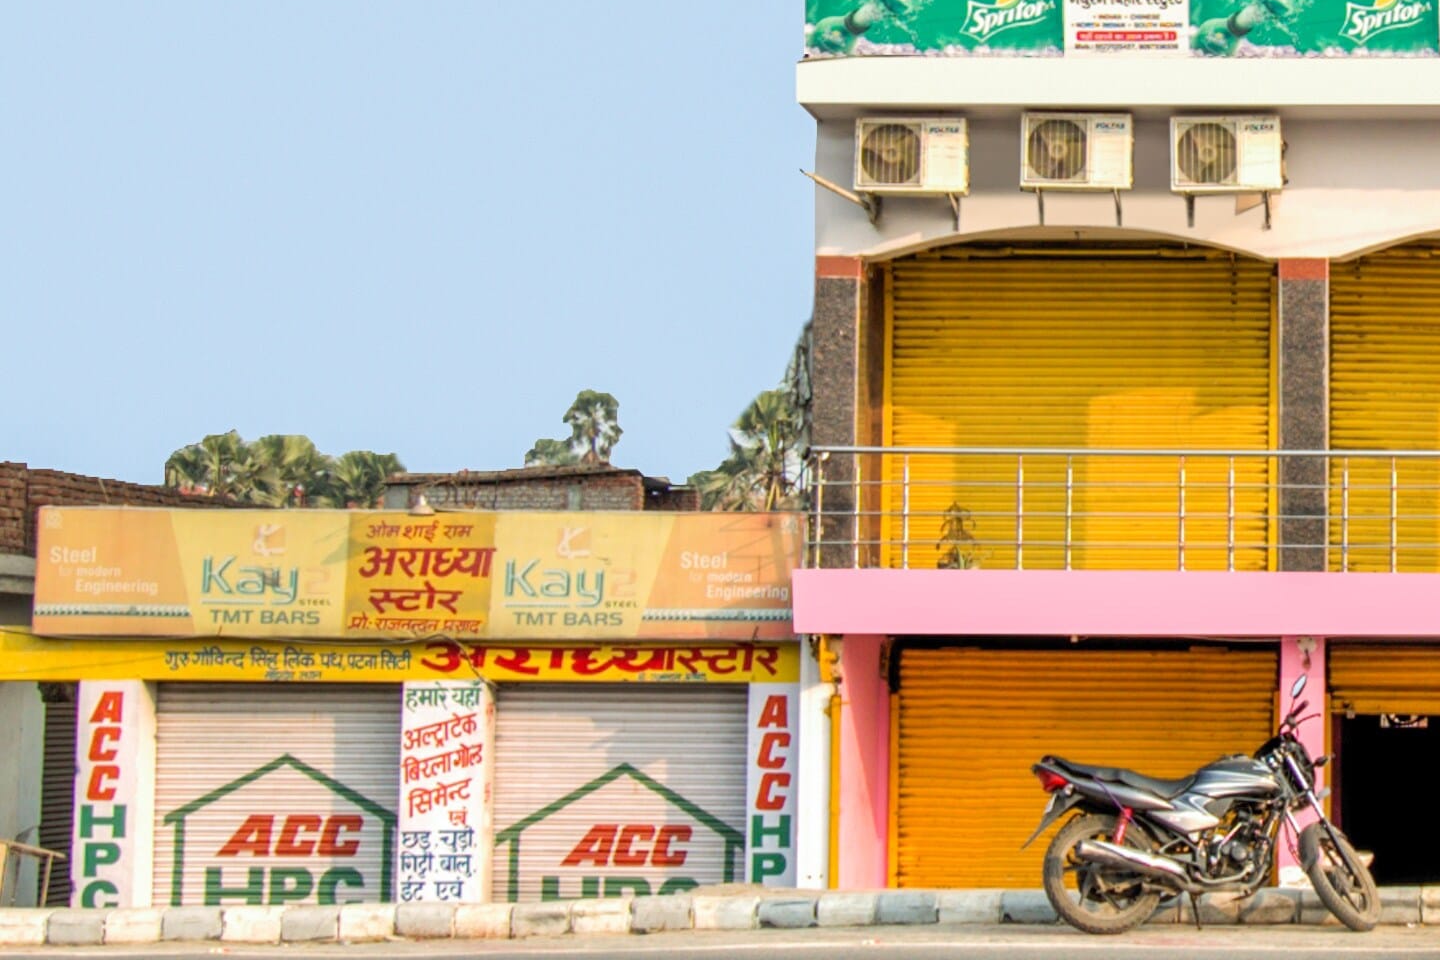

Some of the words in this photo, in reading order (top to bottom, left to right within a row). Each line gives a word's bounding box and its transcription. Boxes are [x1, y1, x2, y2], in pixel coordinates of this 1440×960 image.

[443, 524, 474, 538] राम
[50, 547, 97, 563] Steel
[359, 546, 497, 578] अराध्या
[680, 552, 727, 568] Steel
[76, 565, 121, 577] modern
[706, 571, 752, 582] modern
[76, 580, 158, 595] Engineering
[706, 585, 789, 601] Engineering
[369, 581, 463, 614] स्टोर
[210, 609, 253, 624] TMT
[260, 610, 320, 625] BARS
[513, 611, 557, 626] TMT
[564, 612, 623, 627] BARS
[379, 649, 411, 669] सिटी
[405, 682, 449, 712] हमारे
[216, 815, 364, 857] ACC
[560, 824, 692, 866] ACC
[204, 867, 363, 905] HPC
